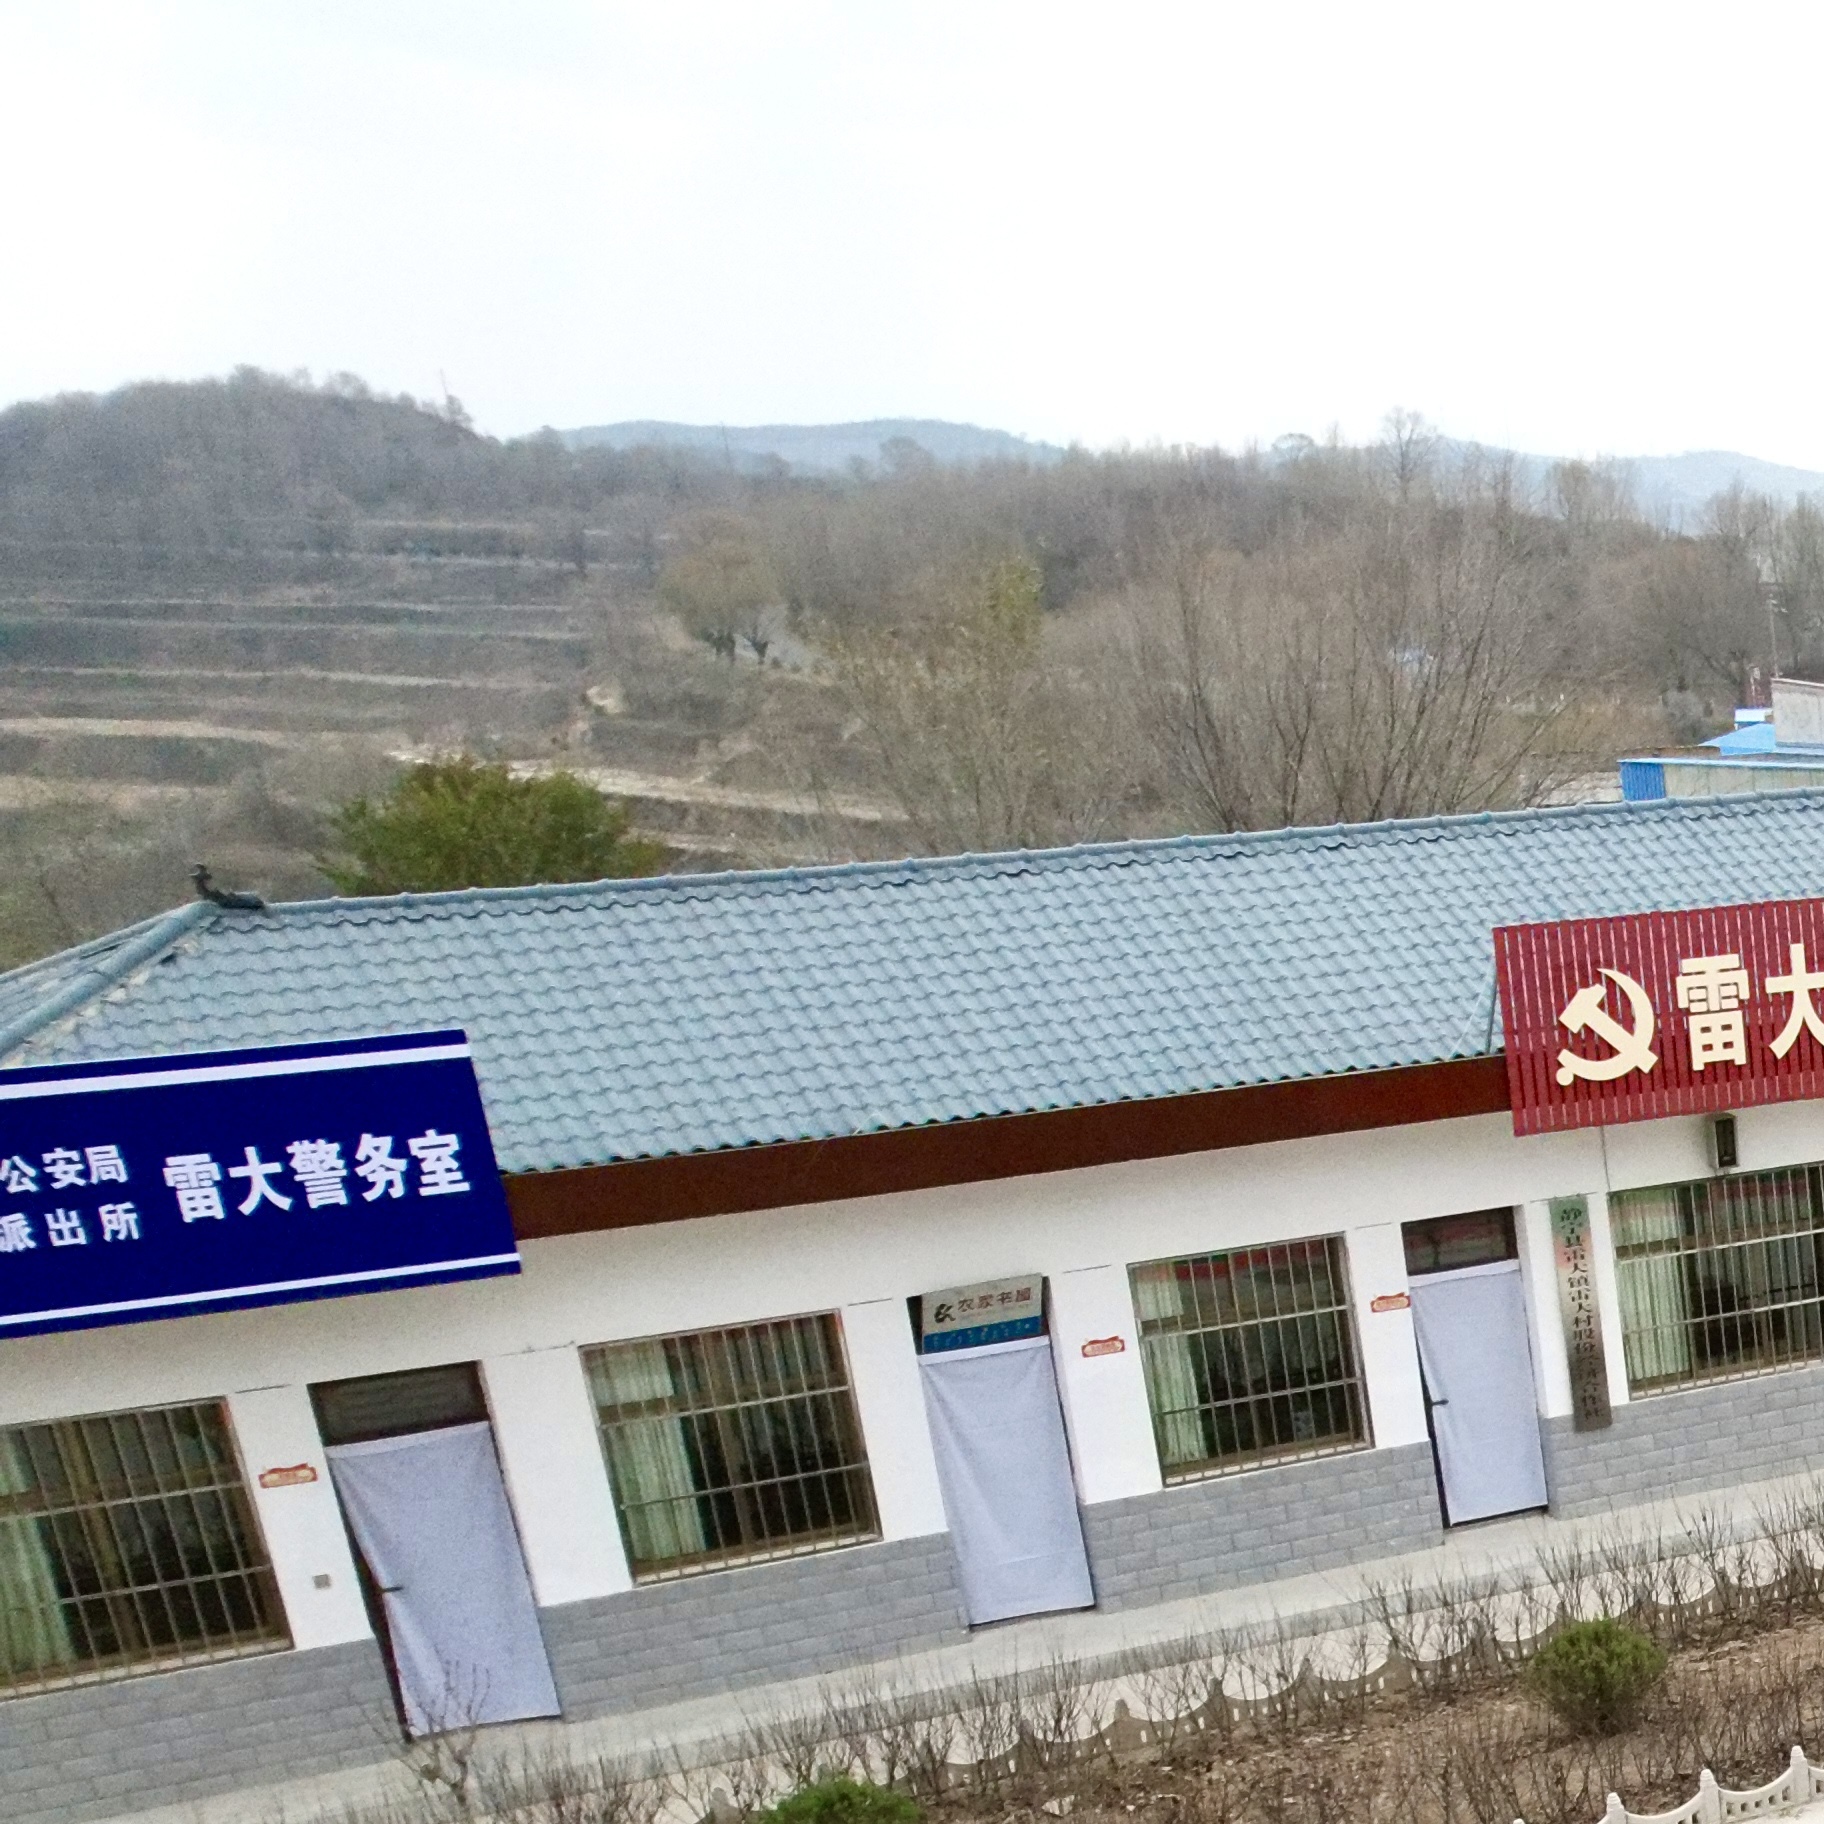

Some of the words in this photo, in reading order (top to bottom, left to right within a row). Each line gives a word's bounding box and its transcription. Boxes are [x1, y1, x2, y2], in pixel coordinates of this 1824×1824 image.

[0, 1144, 128, 1194] 公安局
[162, 1129, 471, 1223] 雷大警务室
